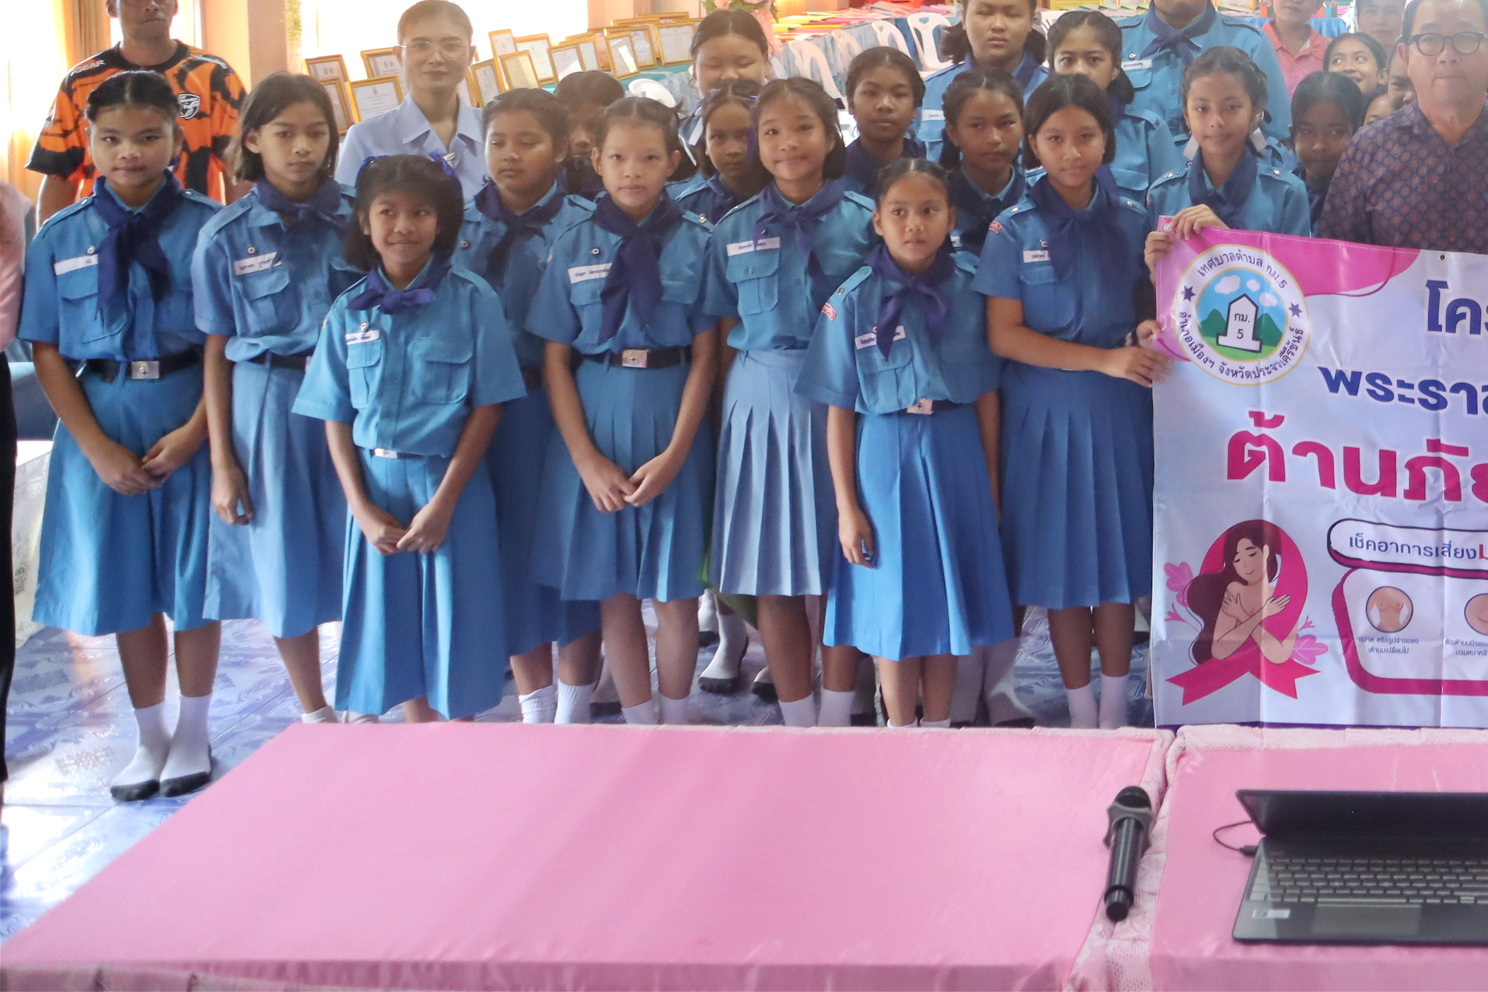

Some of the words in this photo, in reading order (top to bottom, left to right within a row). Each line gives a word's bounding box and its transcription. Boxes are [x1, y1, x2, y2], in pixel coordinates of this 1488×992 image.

[1197, 249, 1264, 278] เทศบาลตำบล
[1233, 312, 1251, 323] กม.
[1236, 328, 1245, 340] 5
